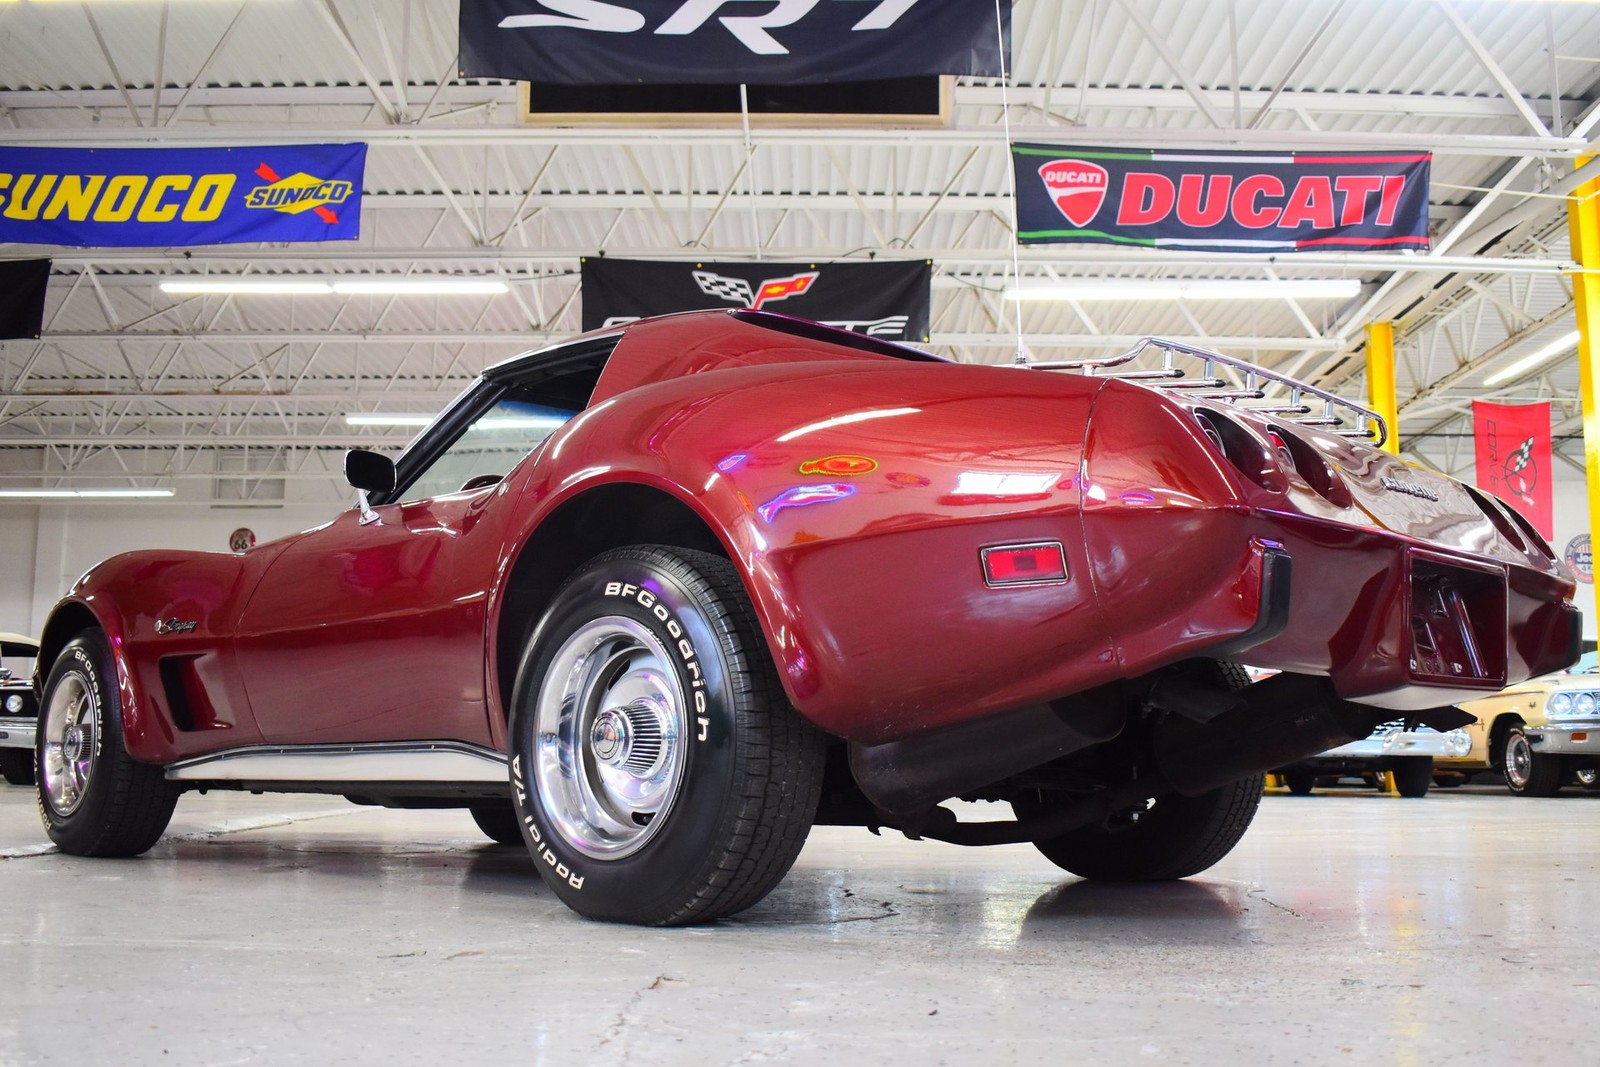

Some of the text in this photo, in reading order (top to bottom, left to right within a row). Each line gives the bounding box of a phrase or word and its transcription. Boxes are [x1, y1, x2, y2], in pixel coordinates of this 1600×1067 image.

[248, 182, 350, 207] SUNOCO
[1045, 170, 1102, 184] DUCATI
[1116, 172, 1406, 229] DUCATI
[1486, 419, 1499, 490] CORVE
[234, 539, 248, 550] 66
[1576, 553, 1592, 563] Je
[604, 581, 710, 742] BFGoodrich
[74, 650, 103, 757] BFGoodrich
[512, 753, 585, 890] Radial T/A
